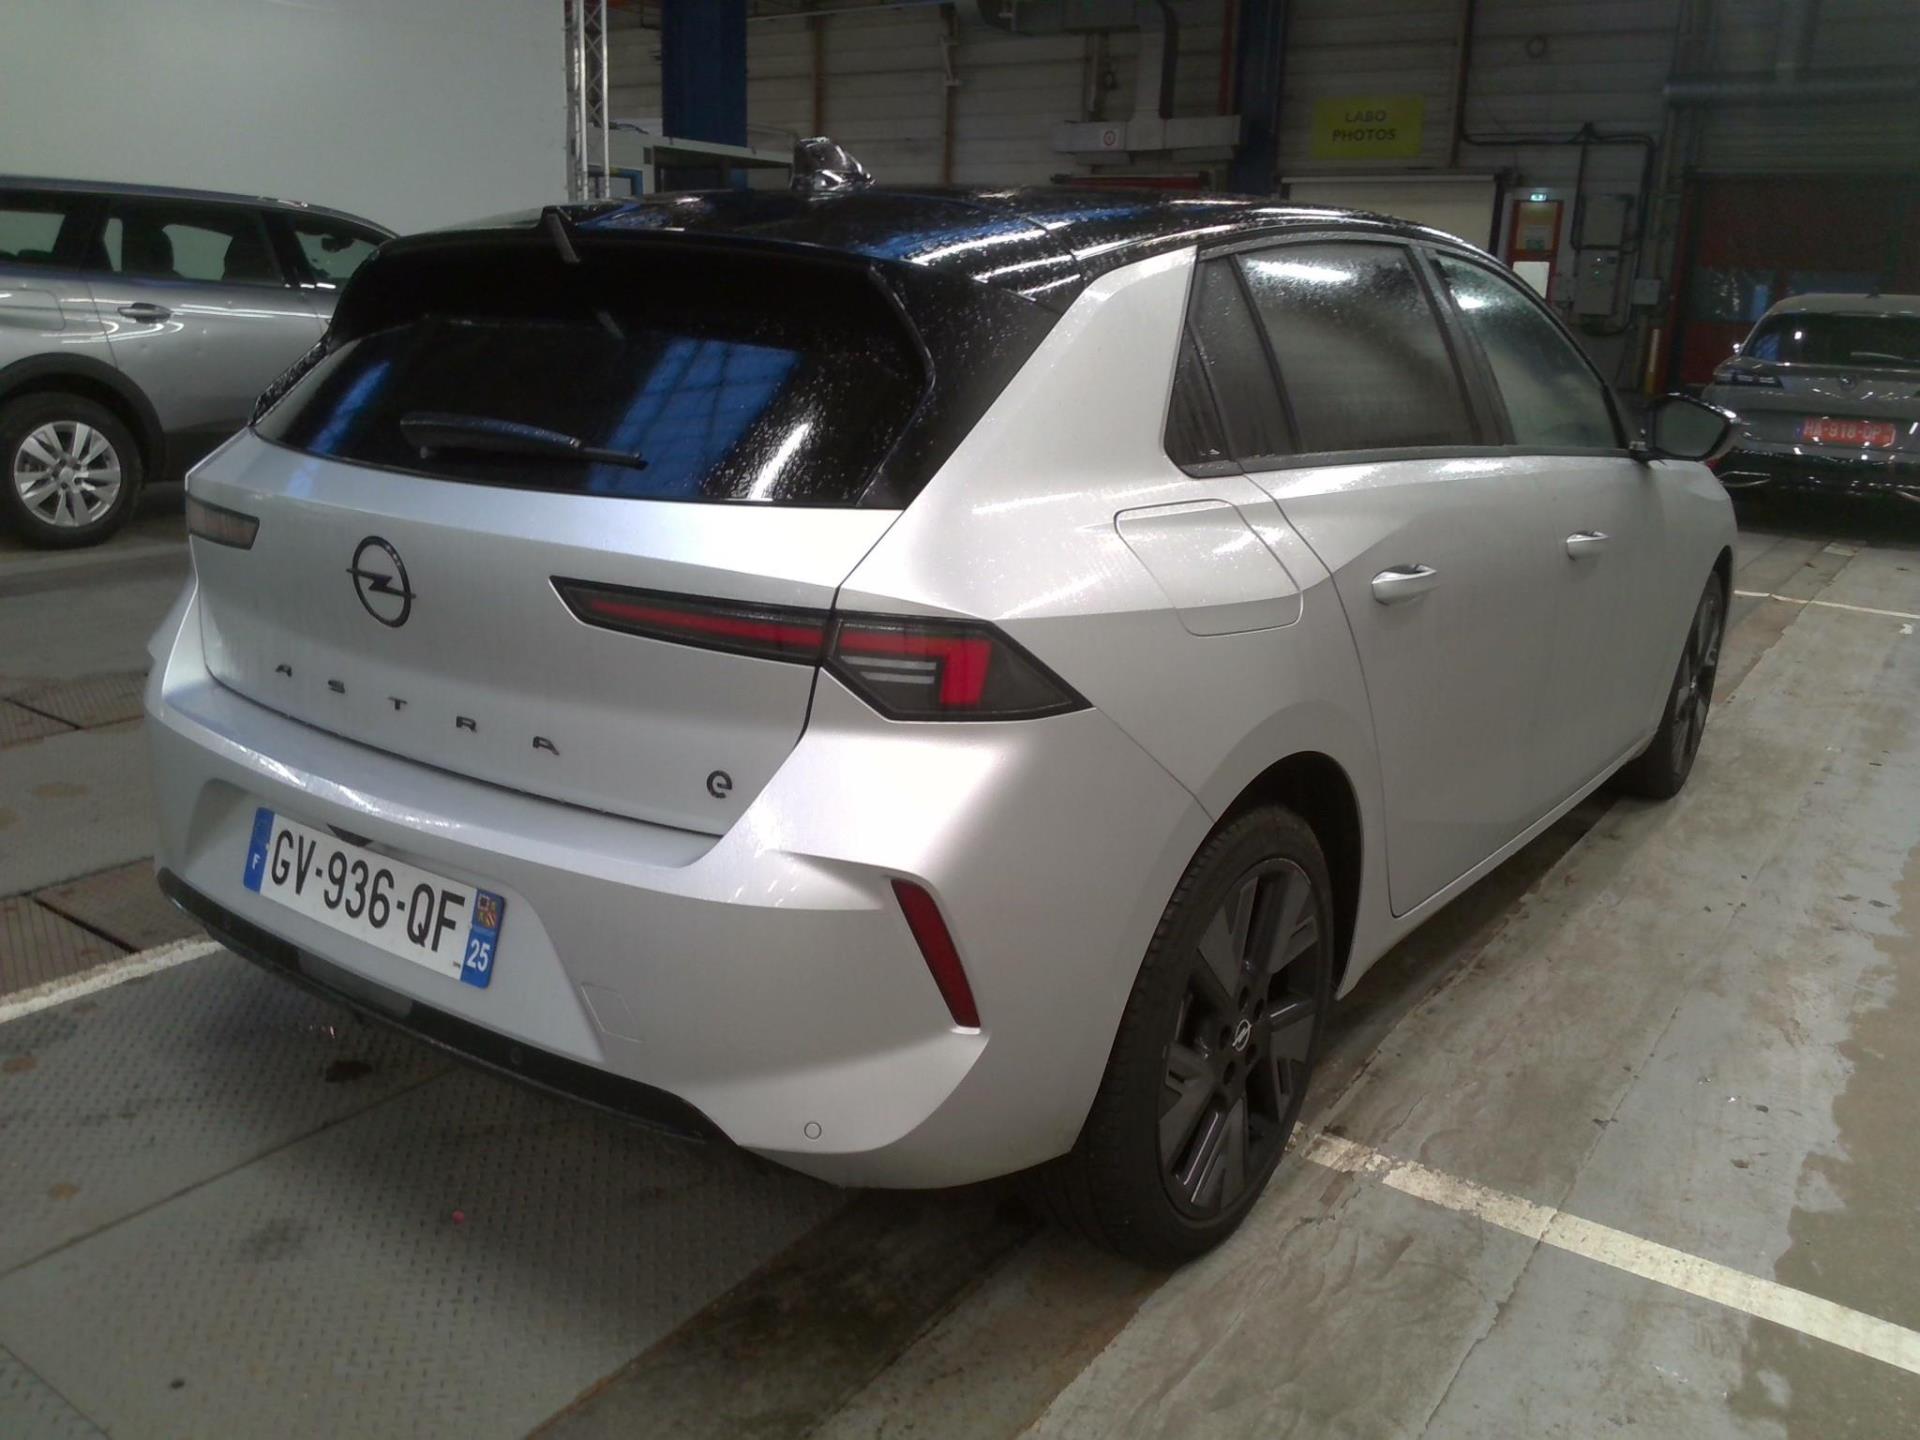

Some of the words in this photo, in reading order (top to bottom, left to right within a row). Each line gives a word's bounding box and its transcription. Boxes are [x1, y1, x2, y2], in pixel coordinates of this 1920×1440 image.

[1345, 109, 1386, 122] LABO
[1332, 128, 1396, 142] PHOTOS
[252, 853, 260, 869] F
[271, 830, 465, 952] GV-936-QF
[467, 939, 490, 972] 25
